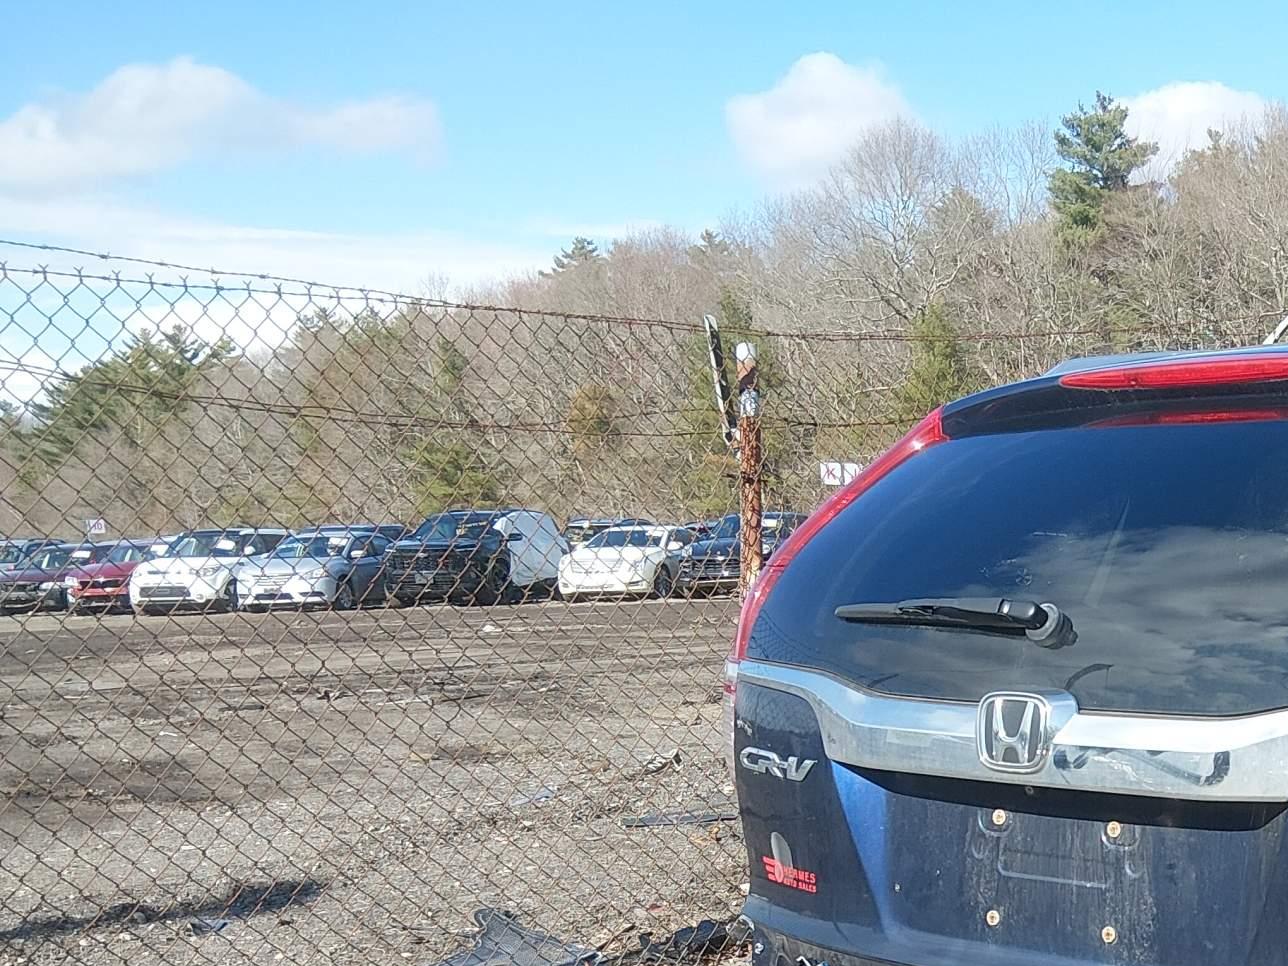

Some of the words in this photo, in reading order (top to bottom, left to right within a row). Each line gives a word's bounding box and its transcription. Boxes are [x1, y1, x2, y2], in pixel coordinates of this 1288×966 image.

[826, 467, 837, 480] K
[740, 746, 818, 782] CR-V
[783, 865, 816, 884] HERMES
[783, 878, 798, 888] AUTO
